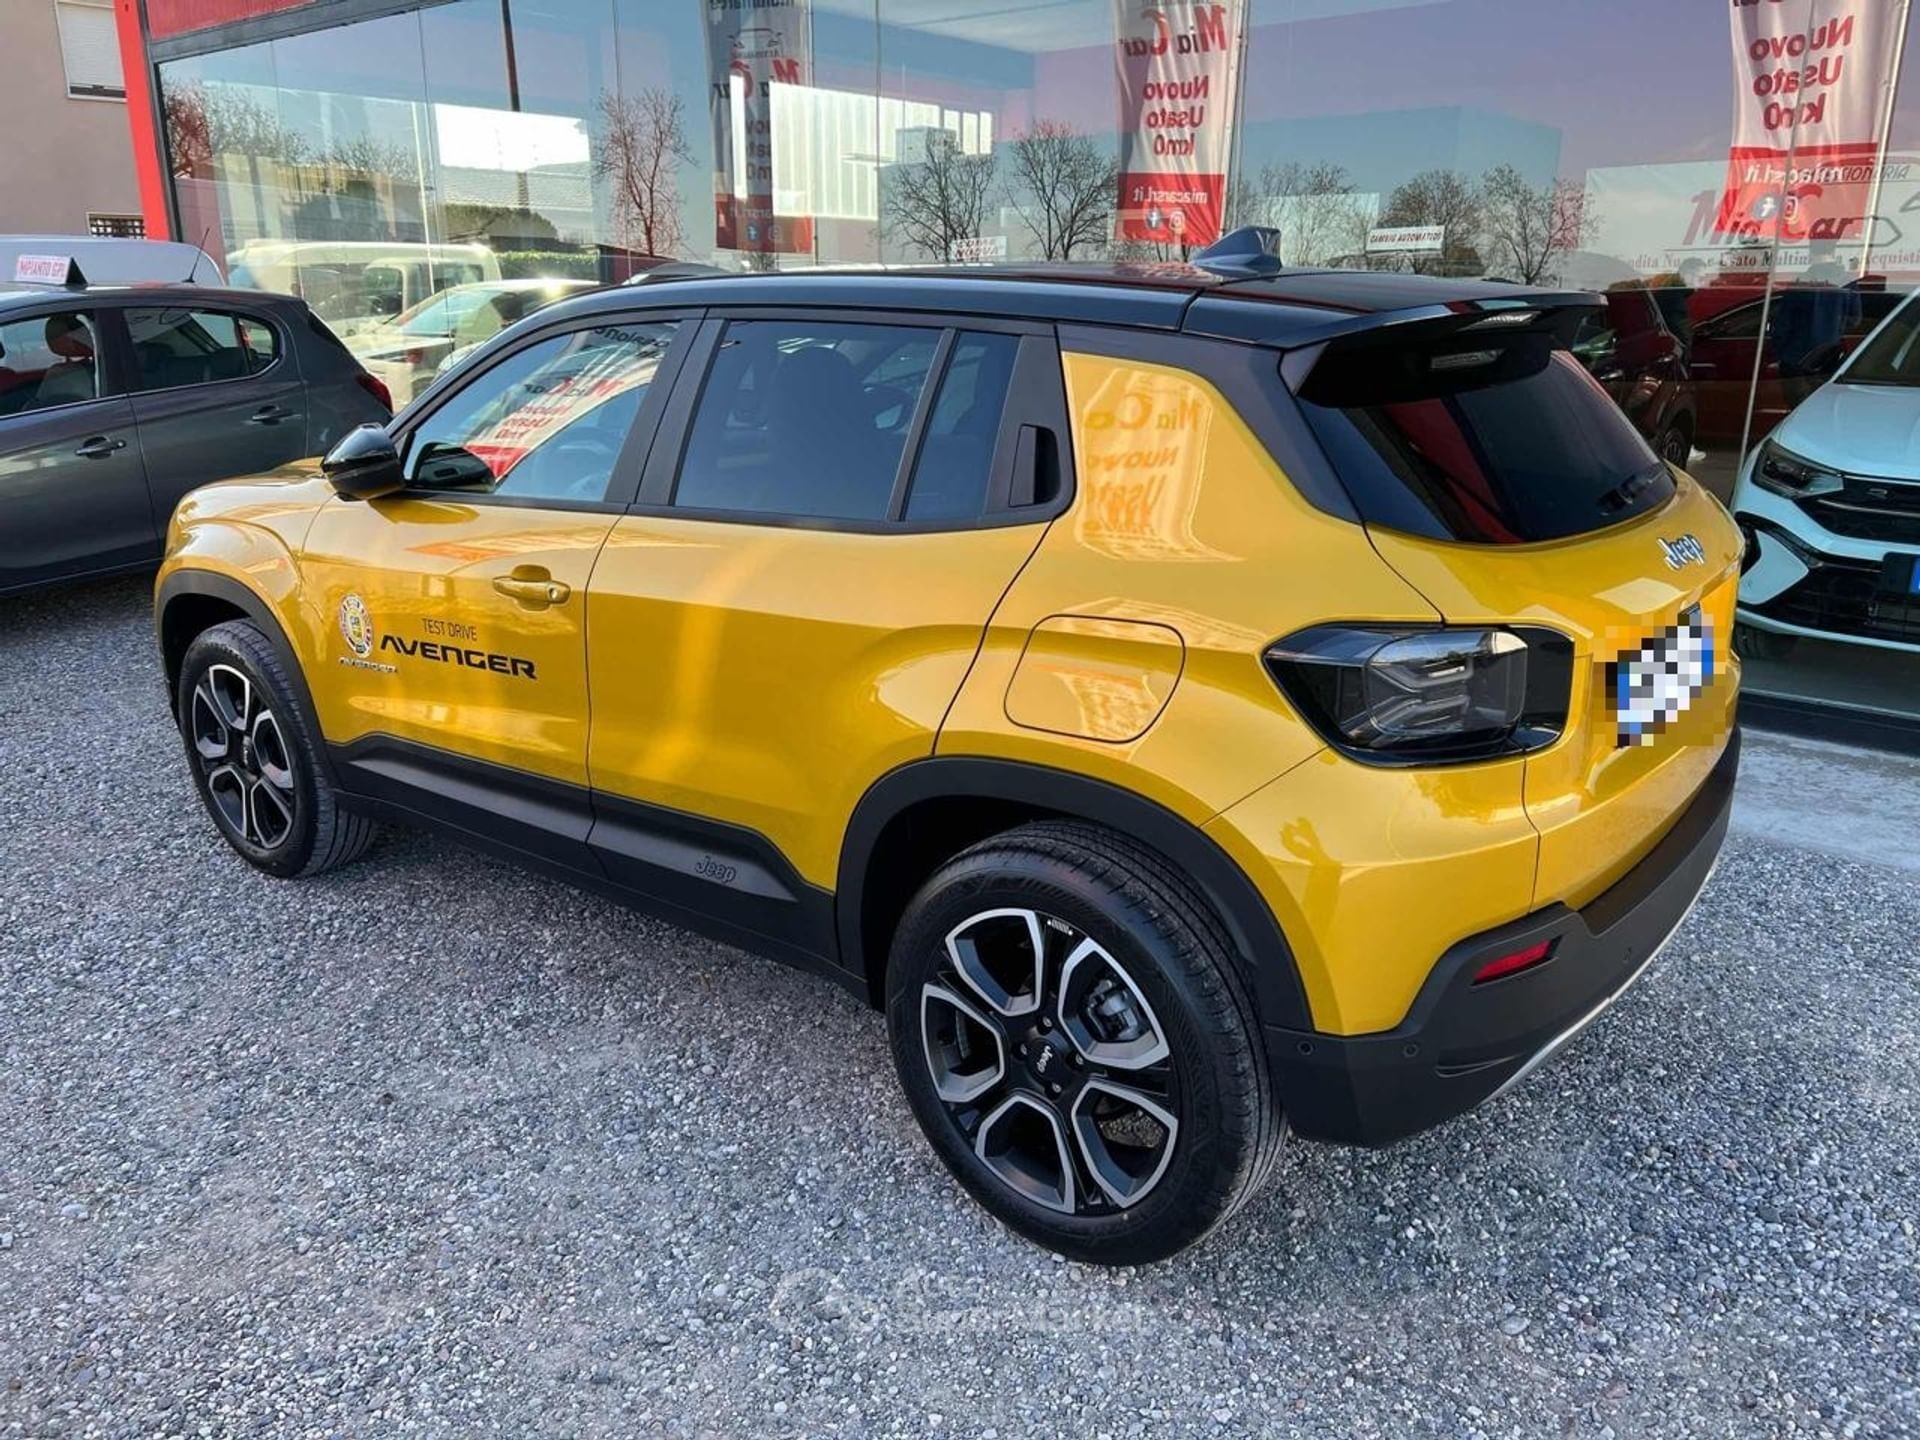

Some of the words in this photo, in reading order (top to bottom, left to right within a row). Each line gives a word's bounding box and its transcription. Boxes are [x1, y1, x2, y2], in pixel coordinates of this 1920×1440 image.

[1682, 189, 1762, 246] Mia
[1655, 535, 1704, 570] Jeep
[421, 618, 446, 635] TEST
[448, 622, 478, 642] DRIVE
[380, 634, 537, 680] AVENGER
[695, 855, 737, 884] Jeep
[1036, 1045, 1053, 1073] Jeep
